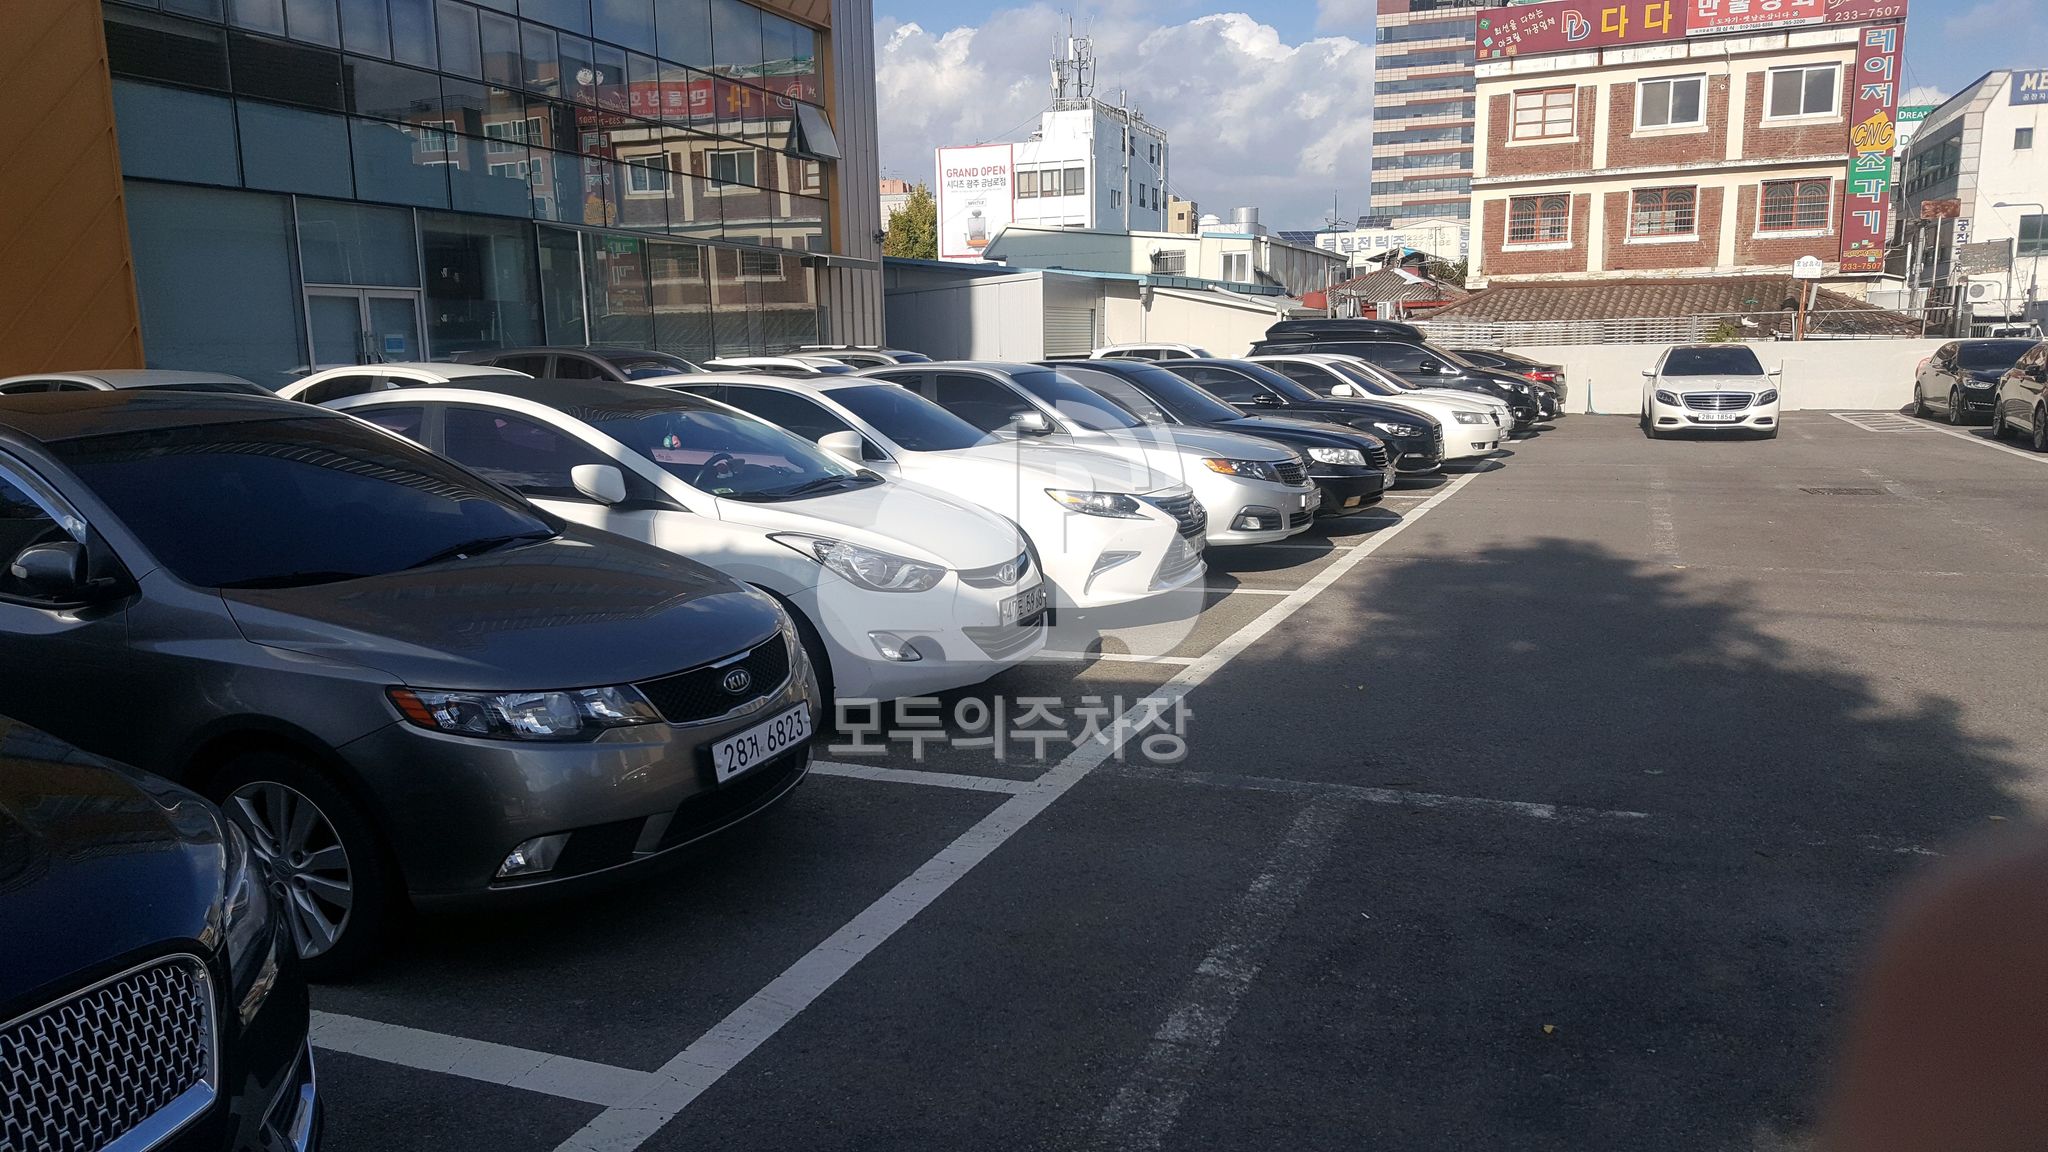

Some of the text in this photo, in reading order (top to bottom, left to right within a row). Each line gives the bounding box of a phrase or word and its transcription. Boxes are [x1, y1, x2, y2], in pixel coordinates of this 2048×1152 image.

[1835, 5, 1901, 22] 233-7507
[1852, 121, 1895, 146] CNC
[946, 165, 1006, 178] GRAND OPEN
[966, 179, 980, 189] 광주
[981, 177, 1006, 188] 금남로점
[1852, 150, 1886, 235] 조각기
[1842, 262, 1882, 271] 233-7507
[728, 672, 748, 690] KIA
[723, 709, 804, 774] 28거 6823
